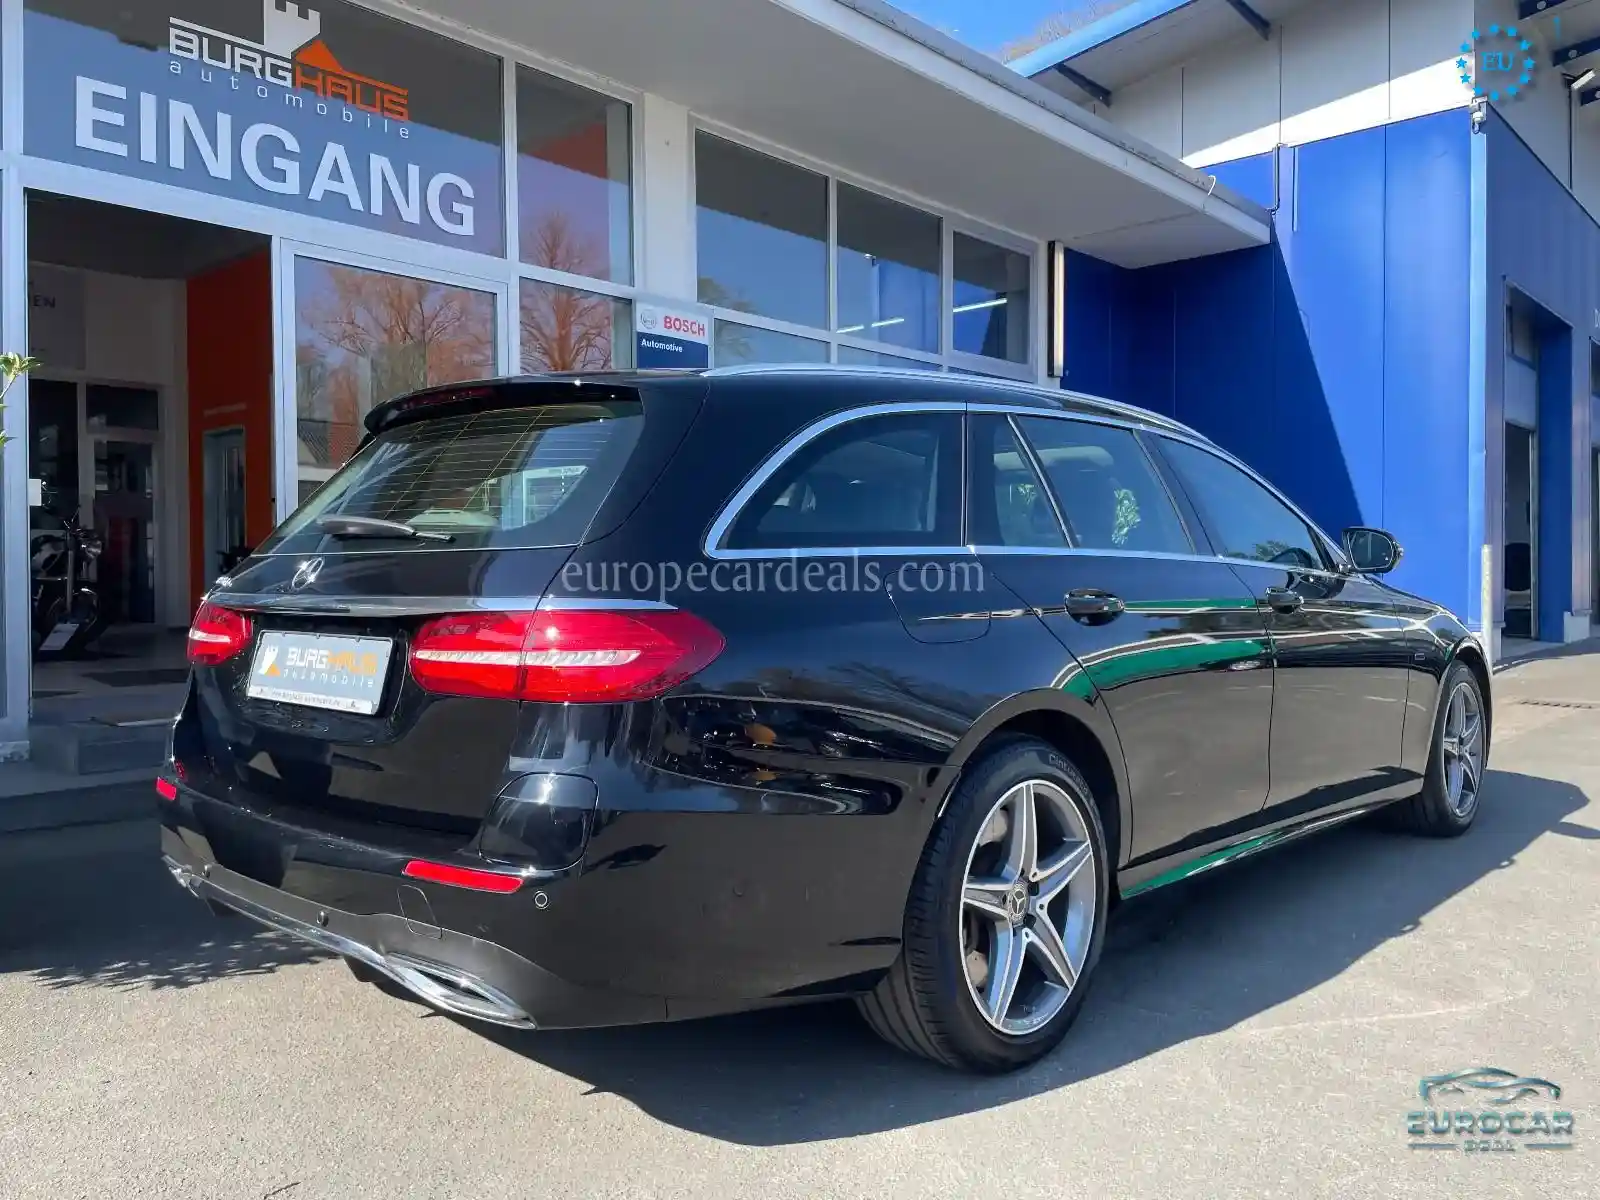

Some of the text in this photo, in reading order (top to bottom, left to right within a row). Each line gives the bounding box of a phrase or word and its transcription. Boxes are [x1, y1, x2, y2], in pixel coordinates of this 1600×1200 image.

[169, 24, 408, 121] BURGHAUS
[169, 60, 409, 140] automobile
[75, 75, 475, 236] EINGANG
[641, 338, 683, 353] Automotive
[663, 315, 706, 337] BOSCH
